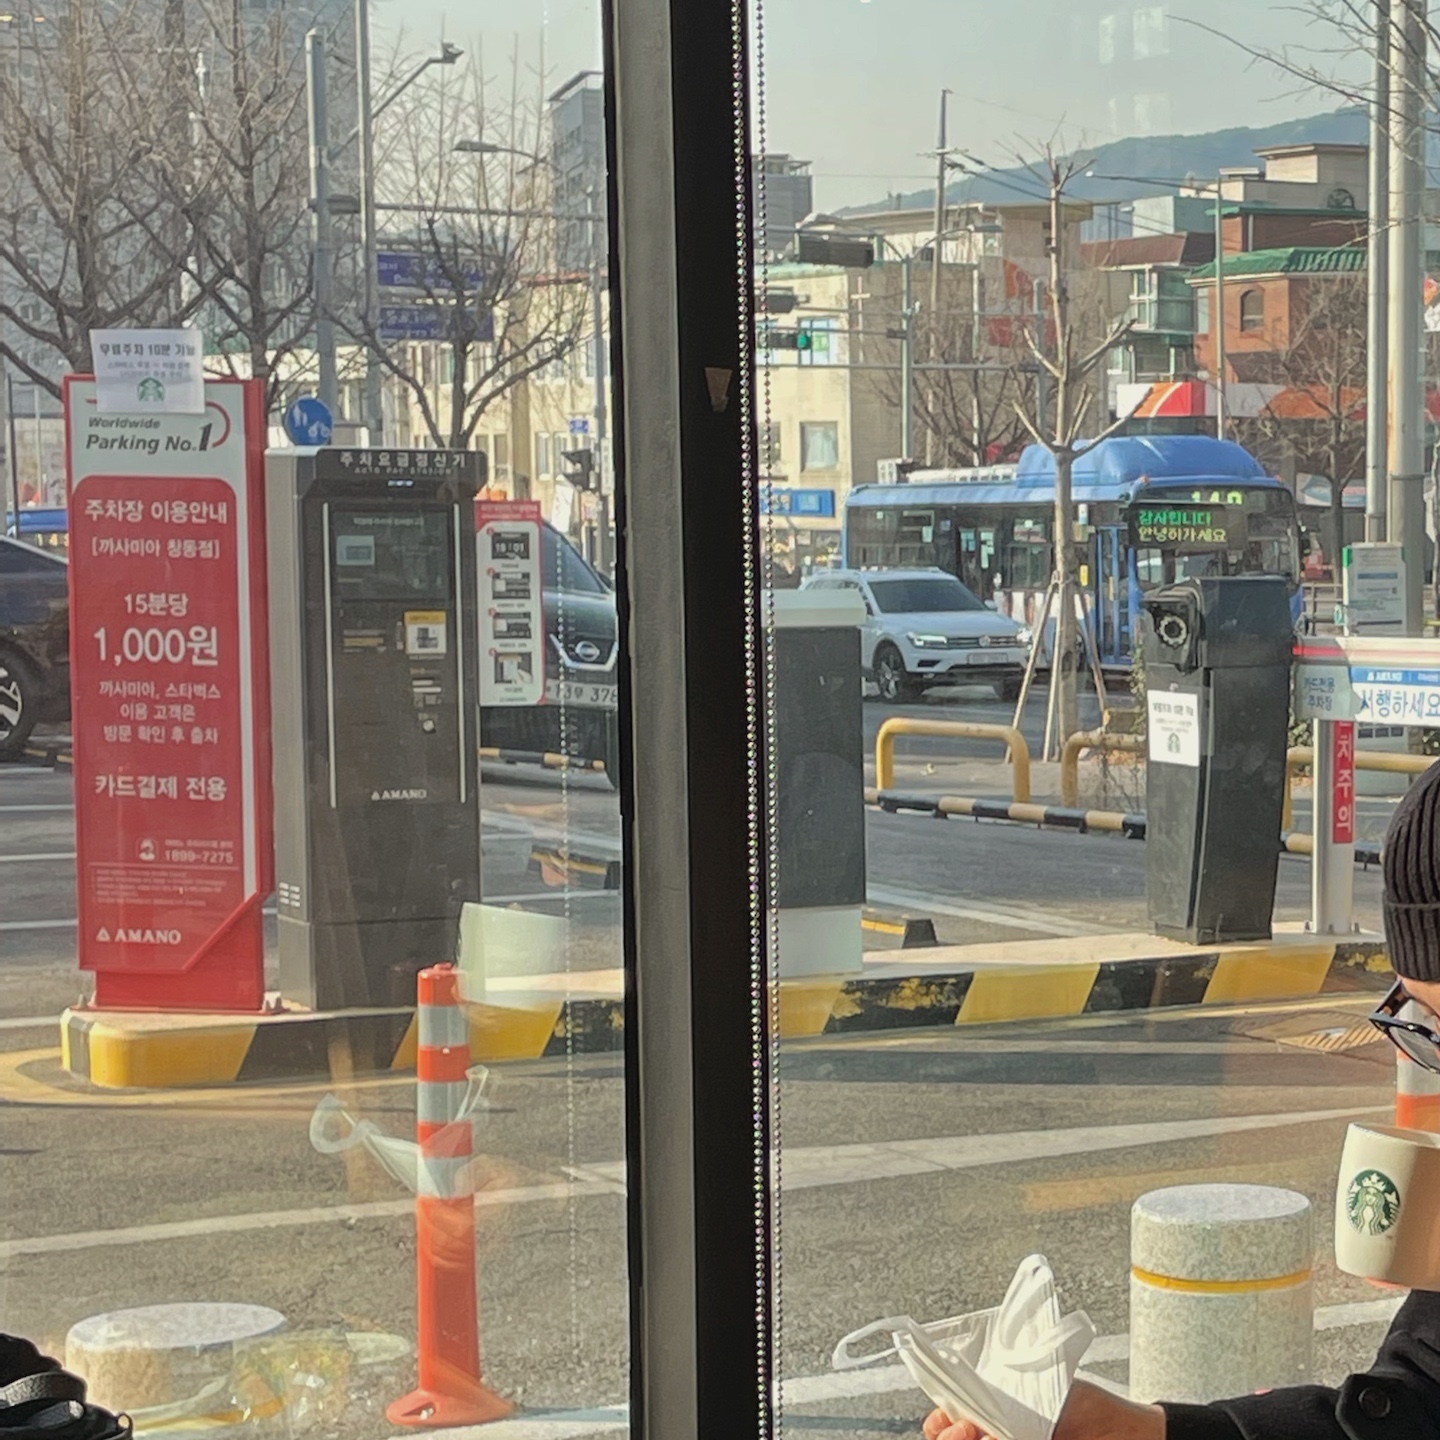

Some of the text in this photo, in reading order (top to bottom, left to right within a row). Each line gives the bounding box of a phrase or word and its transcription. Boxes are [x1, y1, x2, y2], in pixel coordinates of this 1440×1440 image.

[88, 416, 161, 429] Worldwide
[86, 434, 160, 455] Parking
[340, 451, 466, 468] 주차요금정산기
[85, 499, 228, 524] 주차장 이용안내
[1139, 508, 1212, 526] 감사합니다
[124, 593, 189, 617] 15분당
[93, 625, 219, 667] 1,000원
[165, 682, 221, 700] 스타벅스
[120, 703, 196, 722] 이용 고객은
[103, 725, 219, 745] 방문 확인 후 출차
[95, 775, 228, 802] 카드결제 전용
[381, 788, 428, 800] AMANO
[114, 926, 182, 945] AMANO
